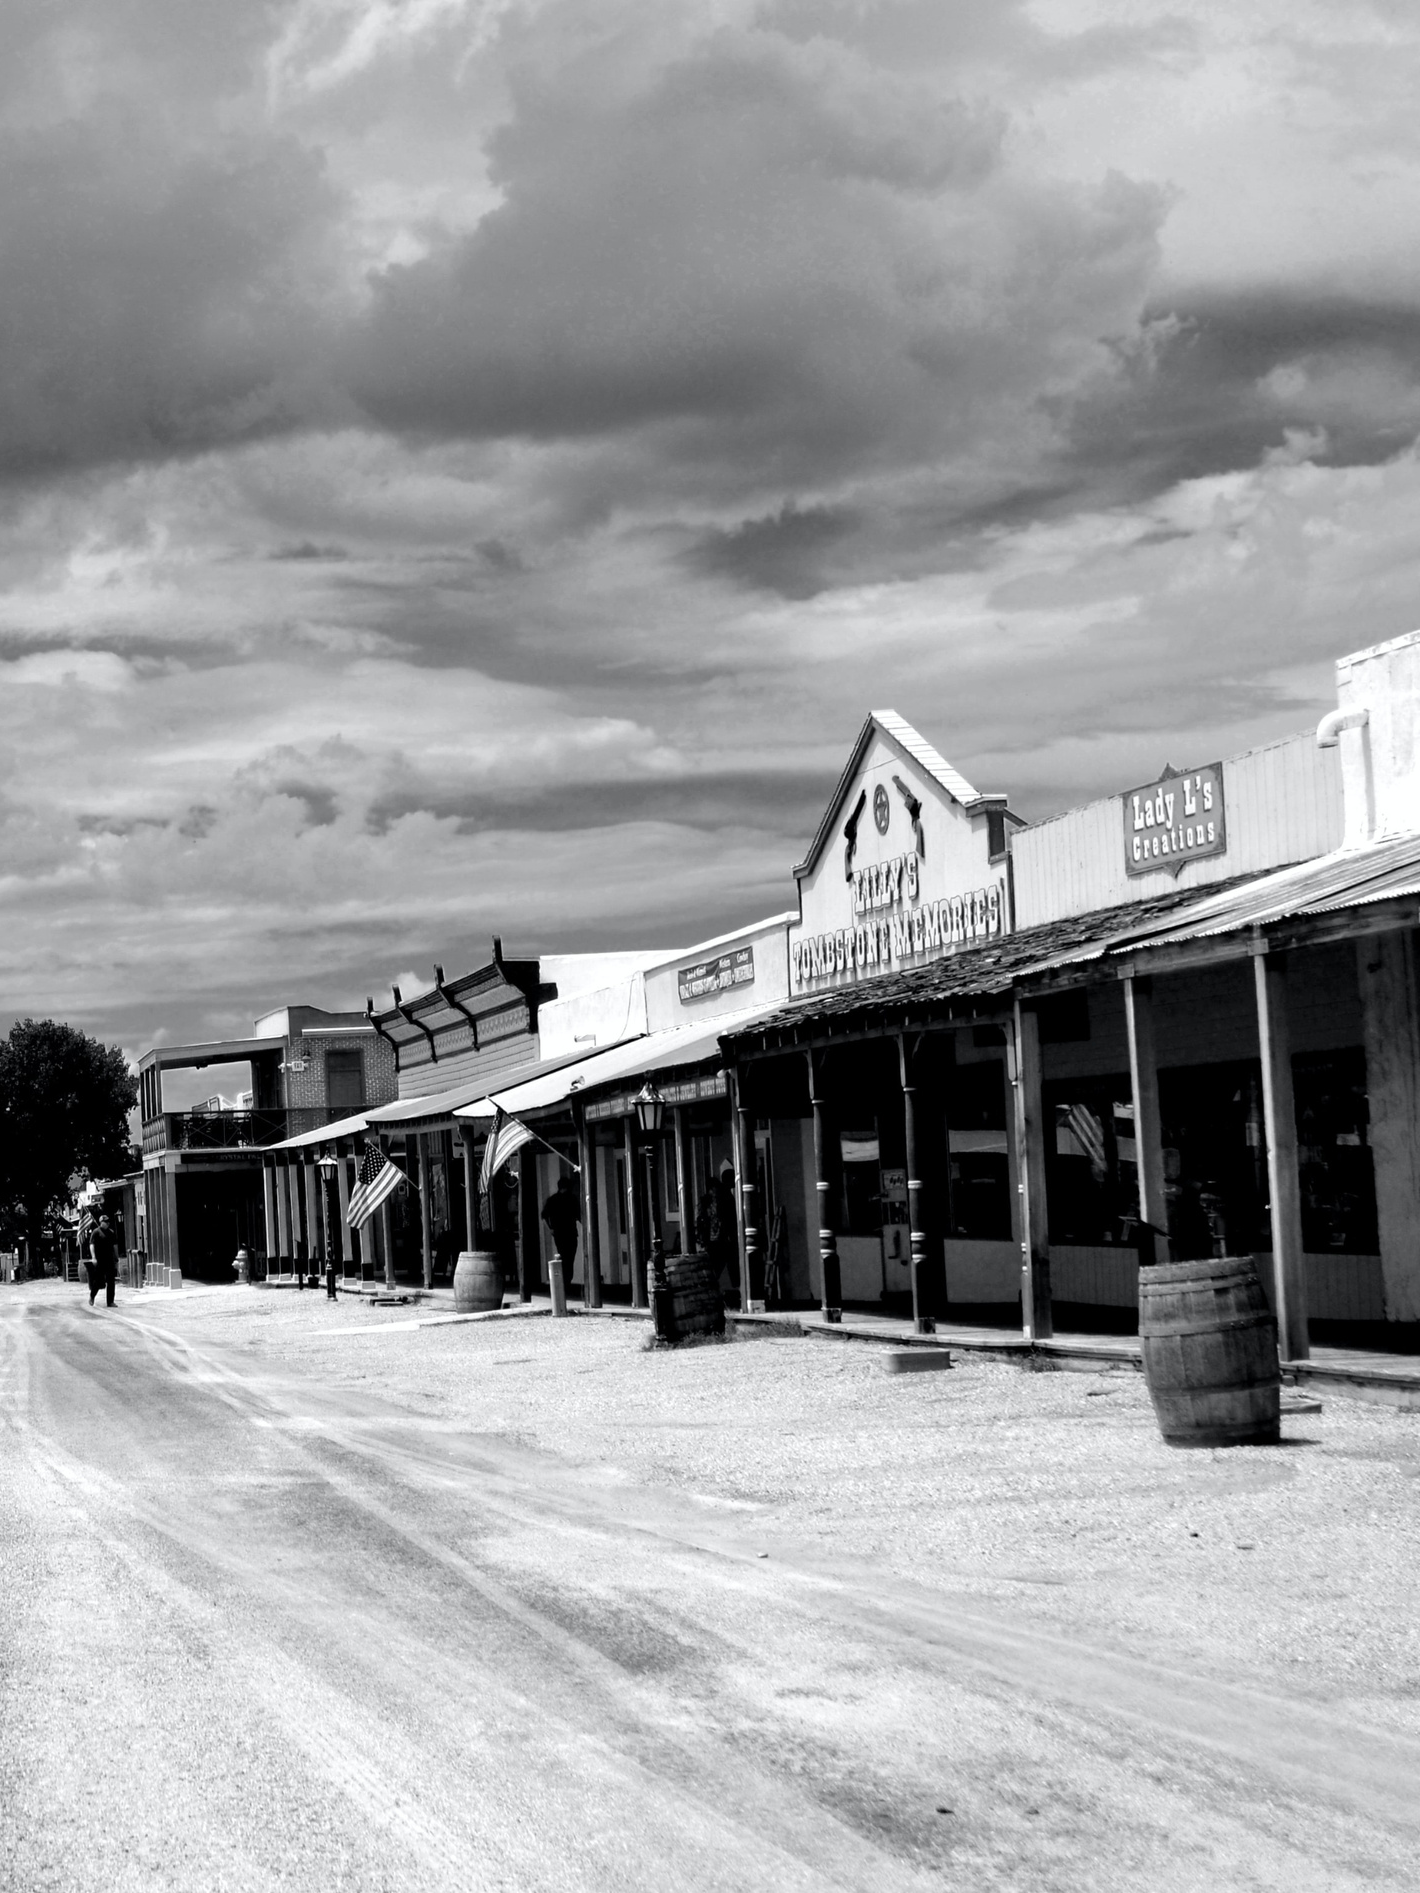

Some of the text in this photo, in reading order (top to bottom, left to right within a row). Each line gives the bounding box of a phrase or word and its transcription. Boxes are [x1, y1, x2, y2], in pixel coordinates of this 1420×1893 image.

[1132, 775, 1213, 831] Lady L's
[1133, 822, 1215, 862] Creations
[853, 851, 918, 915] LILLY'S
[793, 918, 890, 984] TOMBSTONE
[893, 884, 999, 960] MEMORIES
